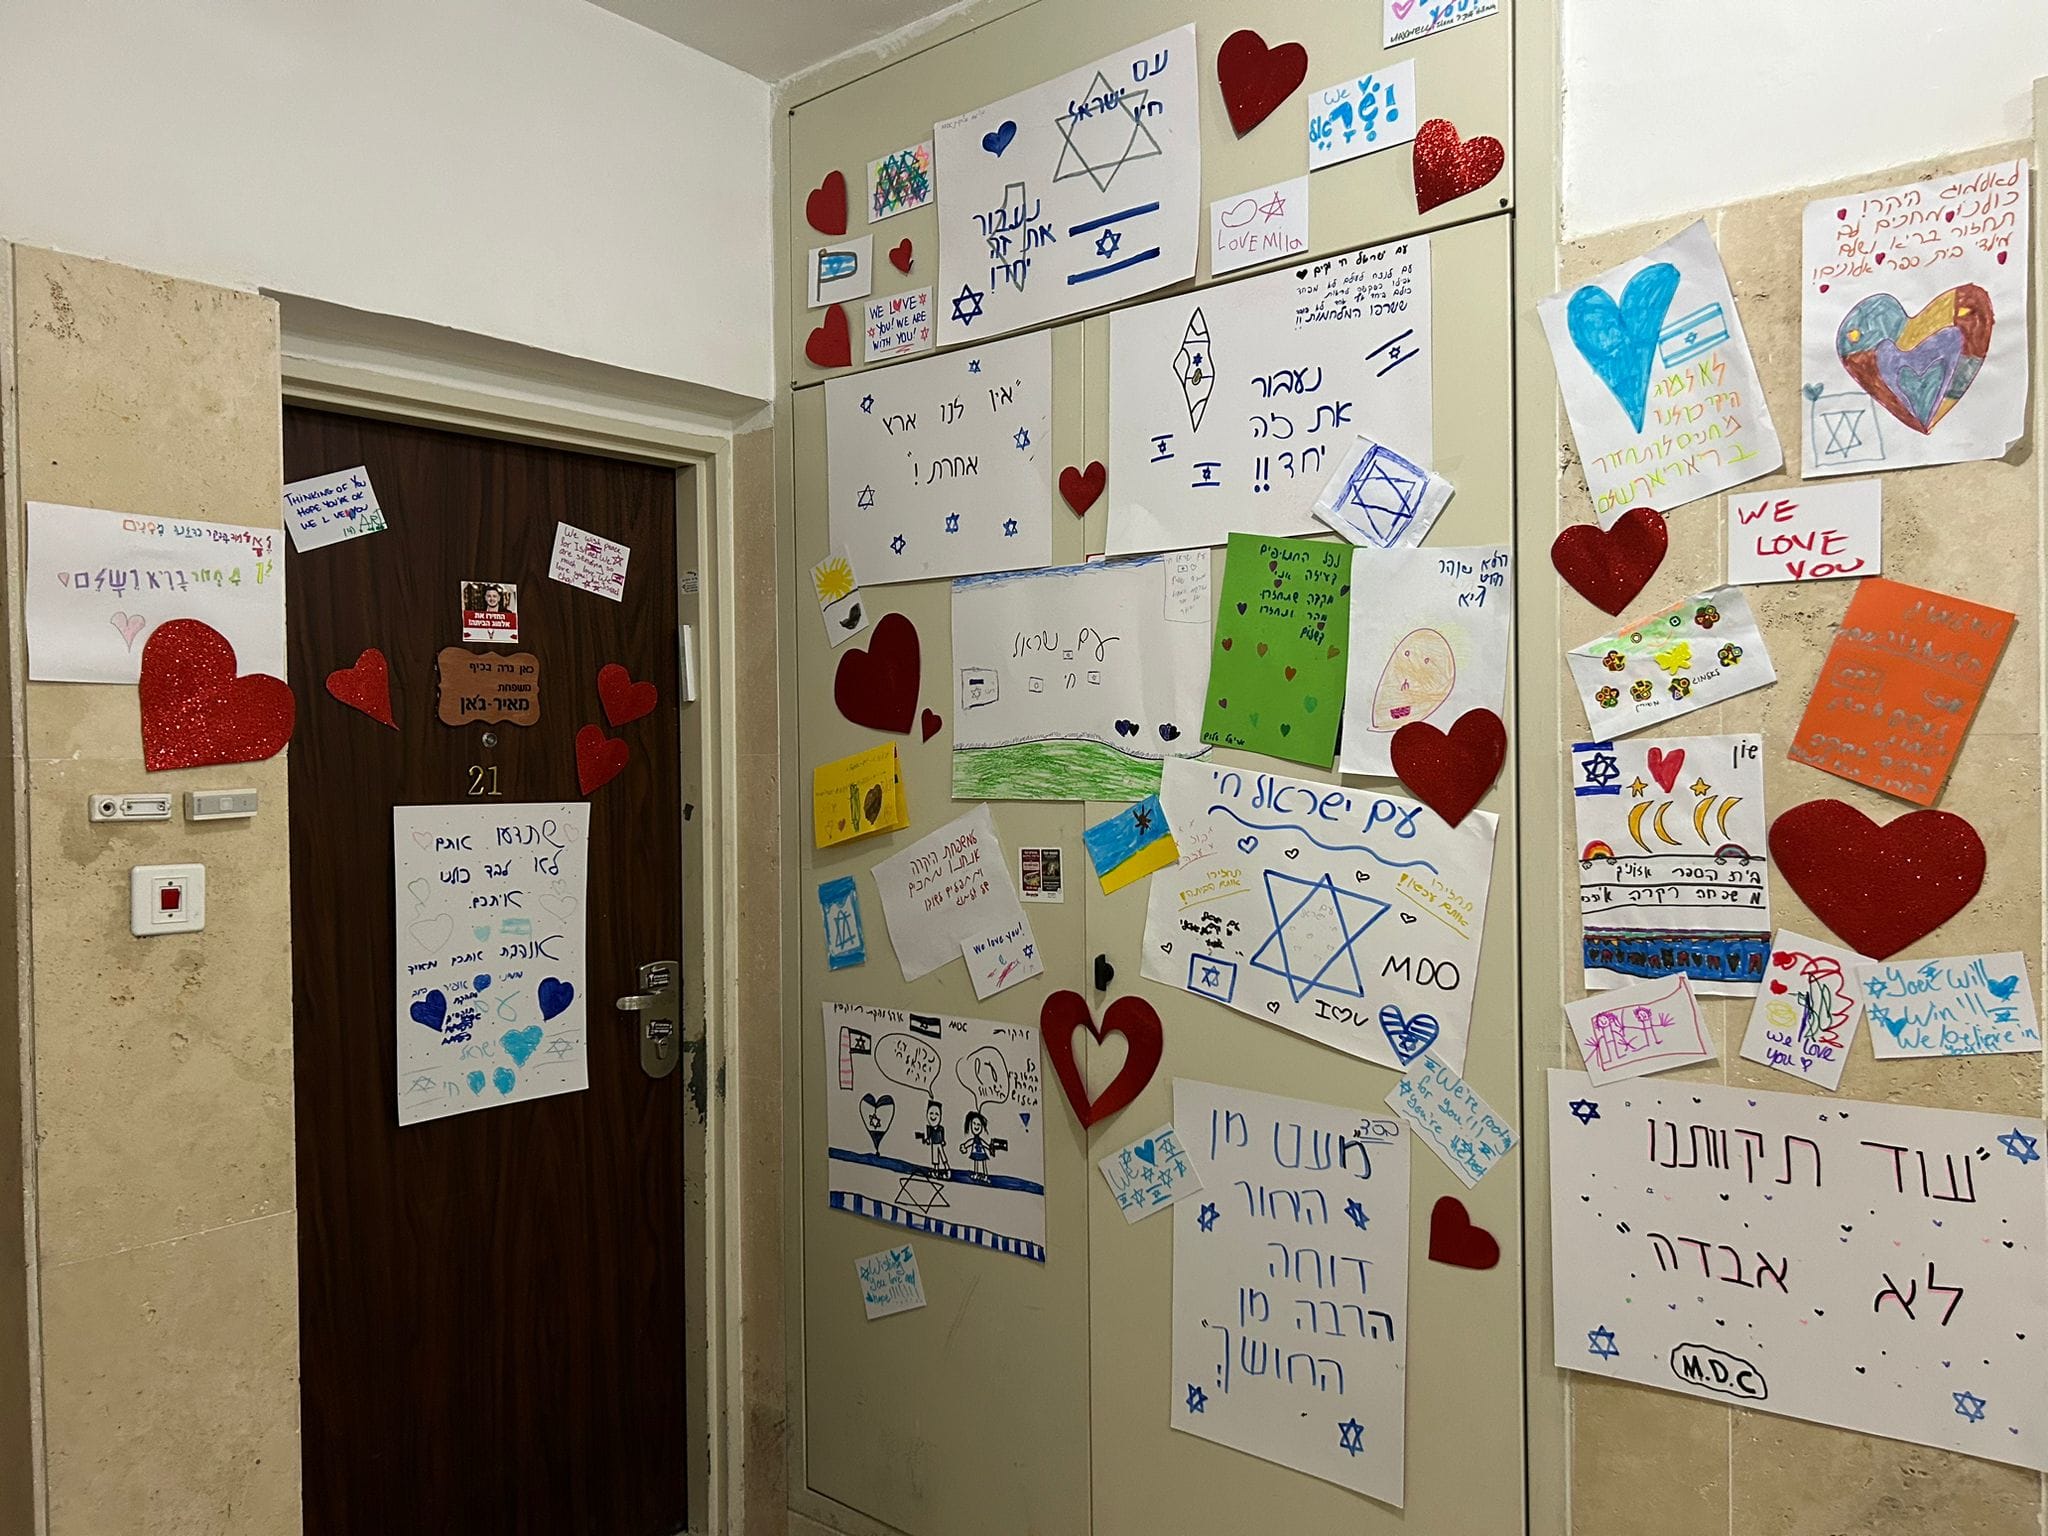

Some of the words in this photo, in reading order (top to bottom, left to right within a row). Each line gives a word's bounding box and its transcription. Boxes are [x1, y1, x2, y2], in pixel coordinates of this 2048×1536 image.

[1133, 50, 1168, 82] עם
[1324, 87, 1351, 106] We
[972, 199, 1041, 236] נעבור
[1218, 230, 1258, 252] LOVE
[1395, 244, 1409, 256] עם
[869, 304, 885, 320] WE
[875, 317, 895, 338] YOU!
[896, 315, 910, 328] WE
[911, 310, 926, 322] ARE
[872, 334, 892, 352] WITH
[896, 328, 917, 347] YOU!
[1251, 367, 1323, 397] נעבור
[940, 395, 965, 424] לנו
[1307, 401, 1352, 433] את
[882, 413, 917, 436] ארץ
[1249, 412, 1294, 439] זה
[283, 487, 334, 507] THINKING
[336, 483, 348, 494] OF
[296, 503, 322, 518] HOPE
[351, 491, 364, 501] OK
[300, 519, 317, 531] WE
[1738, 499, 1800, 525] WE
[1756, 529, 1850, 556] LOVE
[1786, 558, 1866, 582] YOU
[1078, 627, 1121, 663] עם
[469, 663, 492, 674] בכיף
[519, 664, 535, 675] כאן
[497, 683, 532, 693] משפחת
[468, 765, 503, 796] 21
[1212, 771, 1242, 798] חי
[1251, 774, 1352, 822] ישראל
[1361, 798, 1423, 840] עם
[484, 859, 513, 879] לבד
[1671, 866, 1719, 882] הספר
[973, 943, 986, 955] We
[986, 934, 1005, 949] love
[1007, 921, 1027, 946] you!
[1803, 1038, 1837, 1062] love
[1897, 1027, 1936, 1050] We
[1766, 1047, 1797, 1067] you
[1211, 1109, 1249, 1161] מן
[1646, 1118, 1823, 1188] תקוותנו
[1267, 1243, 1374, 1295] דוחה
[1873, 1261, 1965, 1326] לא
[1240, 1287, 1270, 1328] מן
[1295, 1299, 1395, 1342] הרבה
